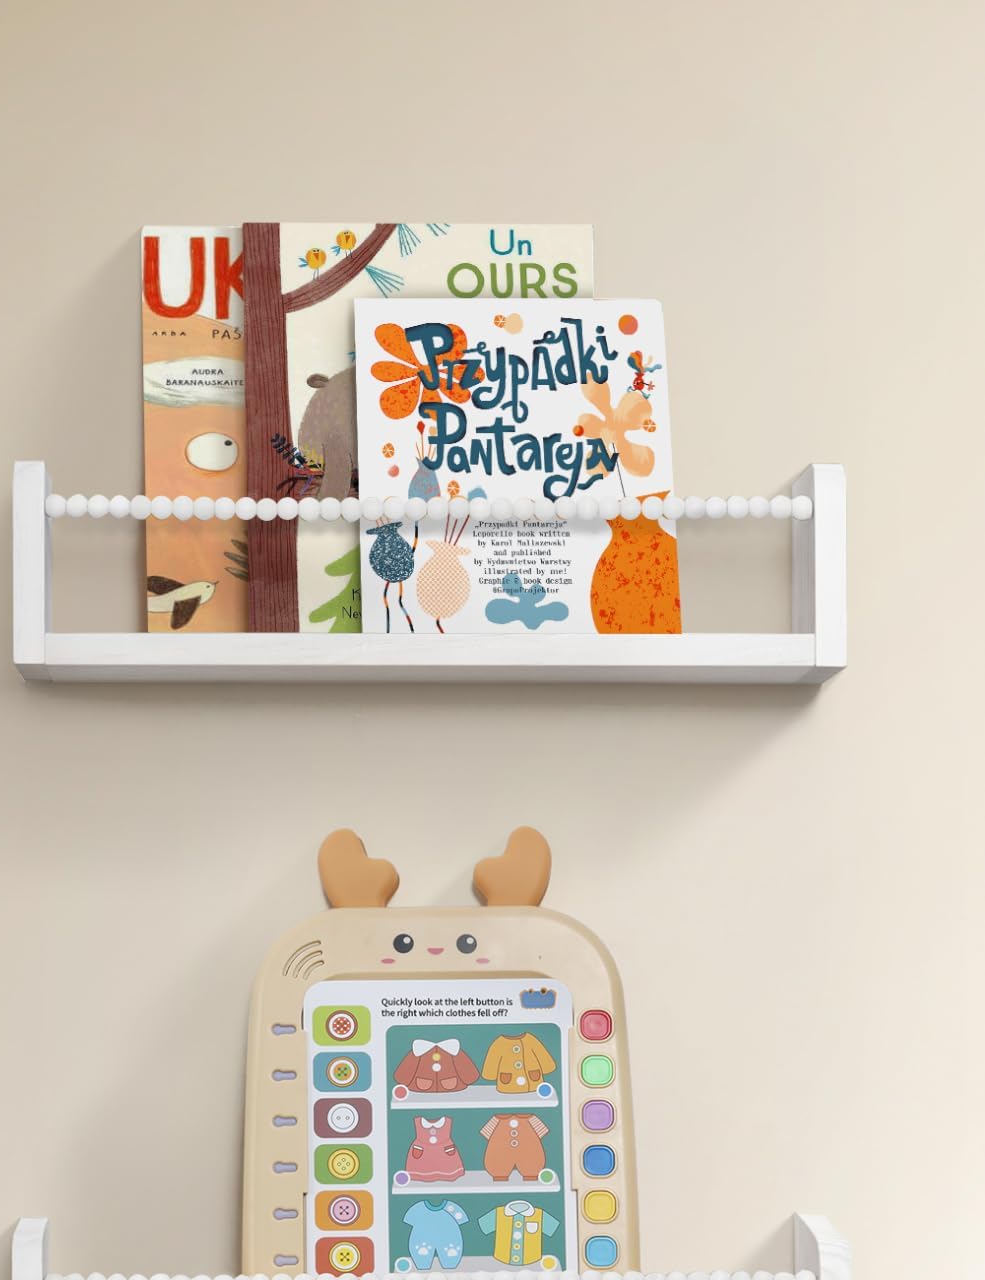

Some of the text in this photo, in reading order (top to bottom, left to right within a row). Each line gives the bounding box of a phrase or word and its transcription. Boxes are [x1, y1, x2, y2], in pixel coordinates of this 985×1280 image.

[489, 229, 532, 256] Un
[446, 262, 578, 299] OURS
[517, 530, 537, 538] book
[539, 530, 571, 538] written
[478, 540, 487, 548] by
[511, 550, 552, 558] published
[474, 559, 483, 567] by
[536, 568, 546, 576] by
[545, 578, 573, 586] design
[381, 998, 413, 1007] Quickly
[414, 998, 432, 1006] look
[444, 998, 459, 1006] the
[460, 998, 475, 1006] left
[476, 998, 504, 1006] button
[506, 998, 513, 1006] is
[381, 1008, 508, 1019] the right which clothes fell off?
